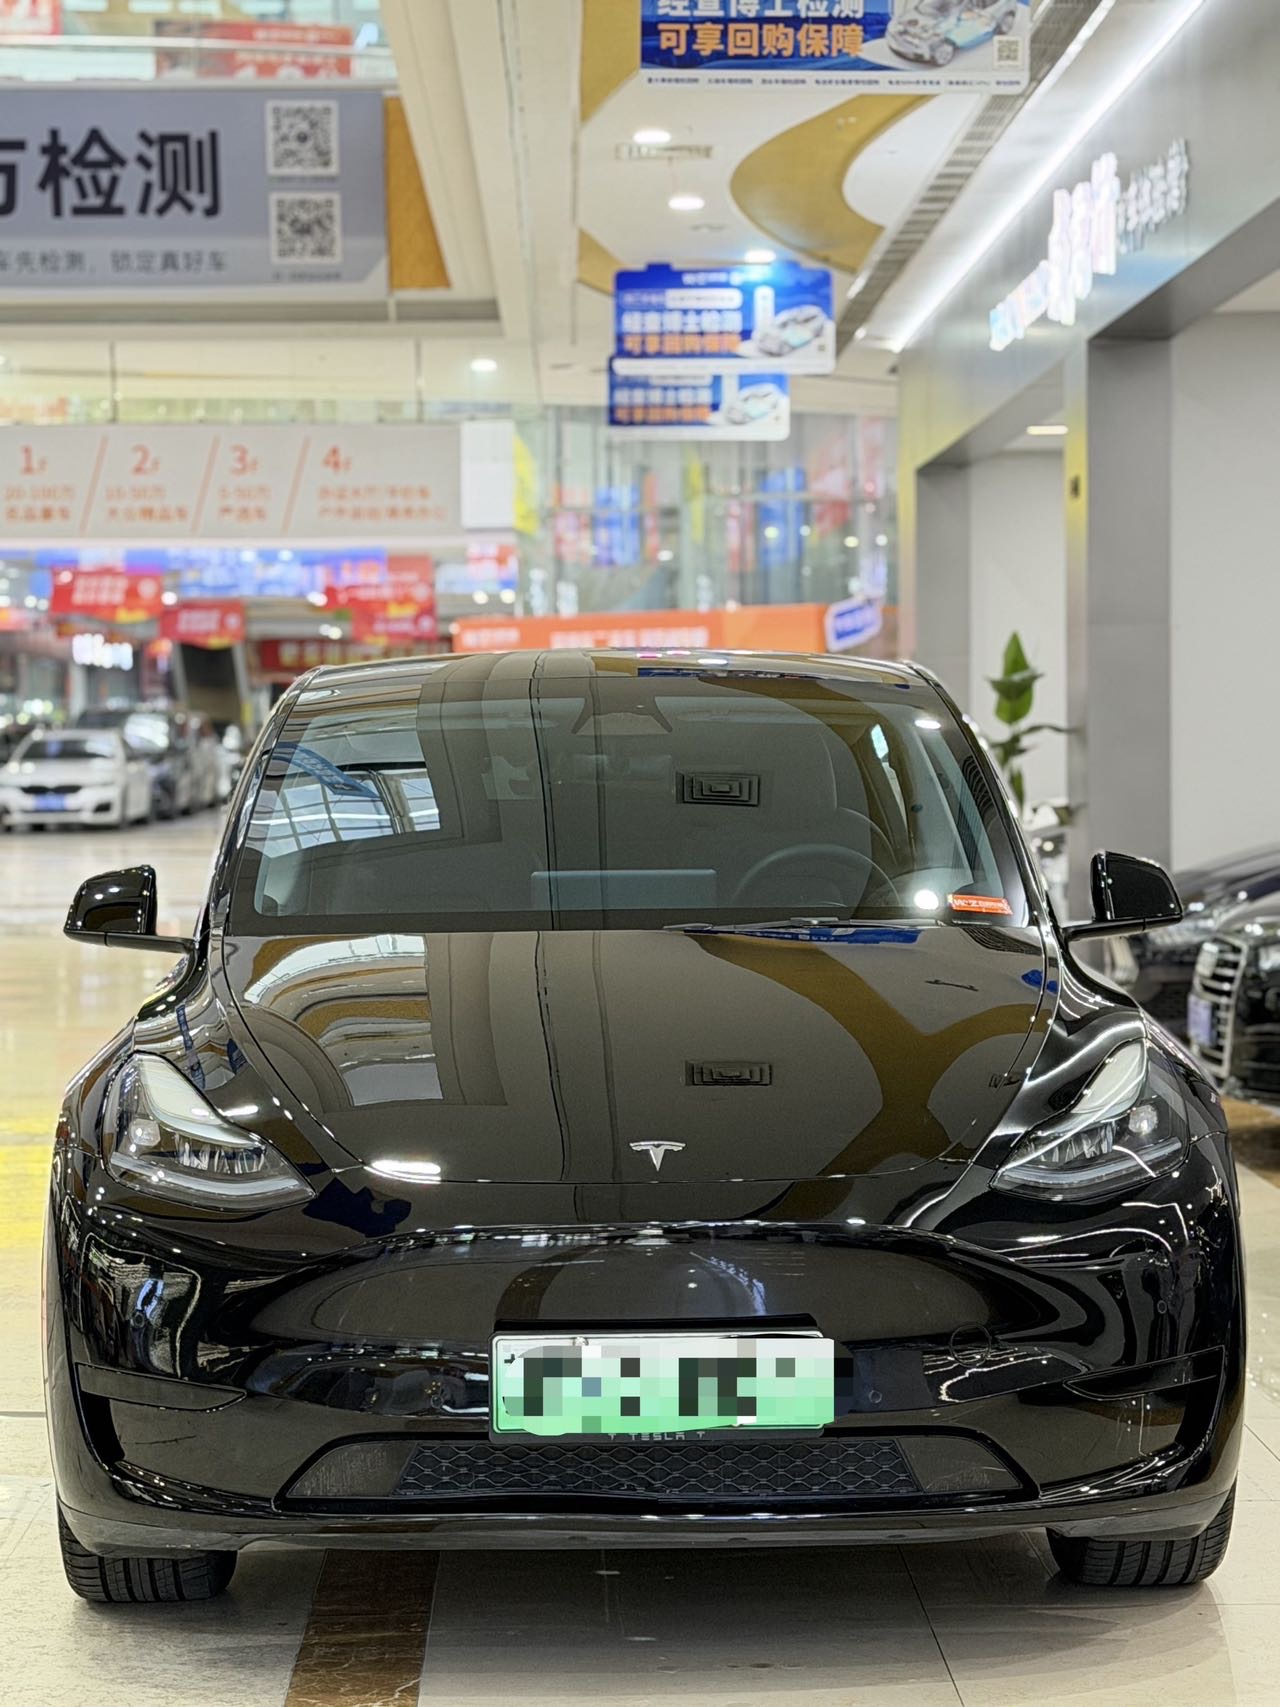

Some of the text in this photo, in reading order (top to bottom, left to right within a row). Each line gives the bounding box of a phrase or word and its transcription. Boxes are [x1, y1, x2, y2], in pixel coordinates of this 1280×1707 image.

[657, 22, 865, 57] 可享回购保障
[628, 1432, 686, 1441] TESLA
